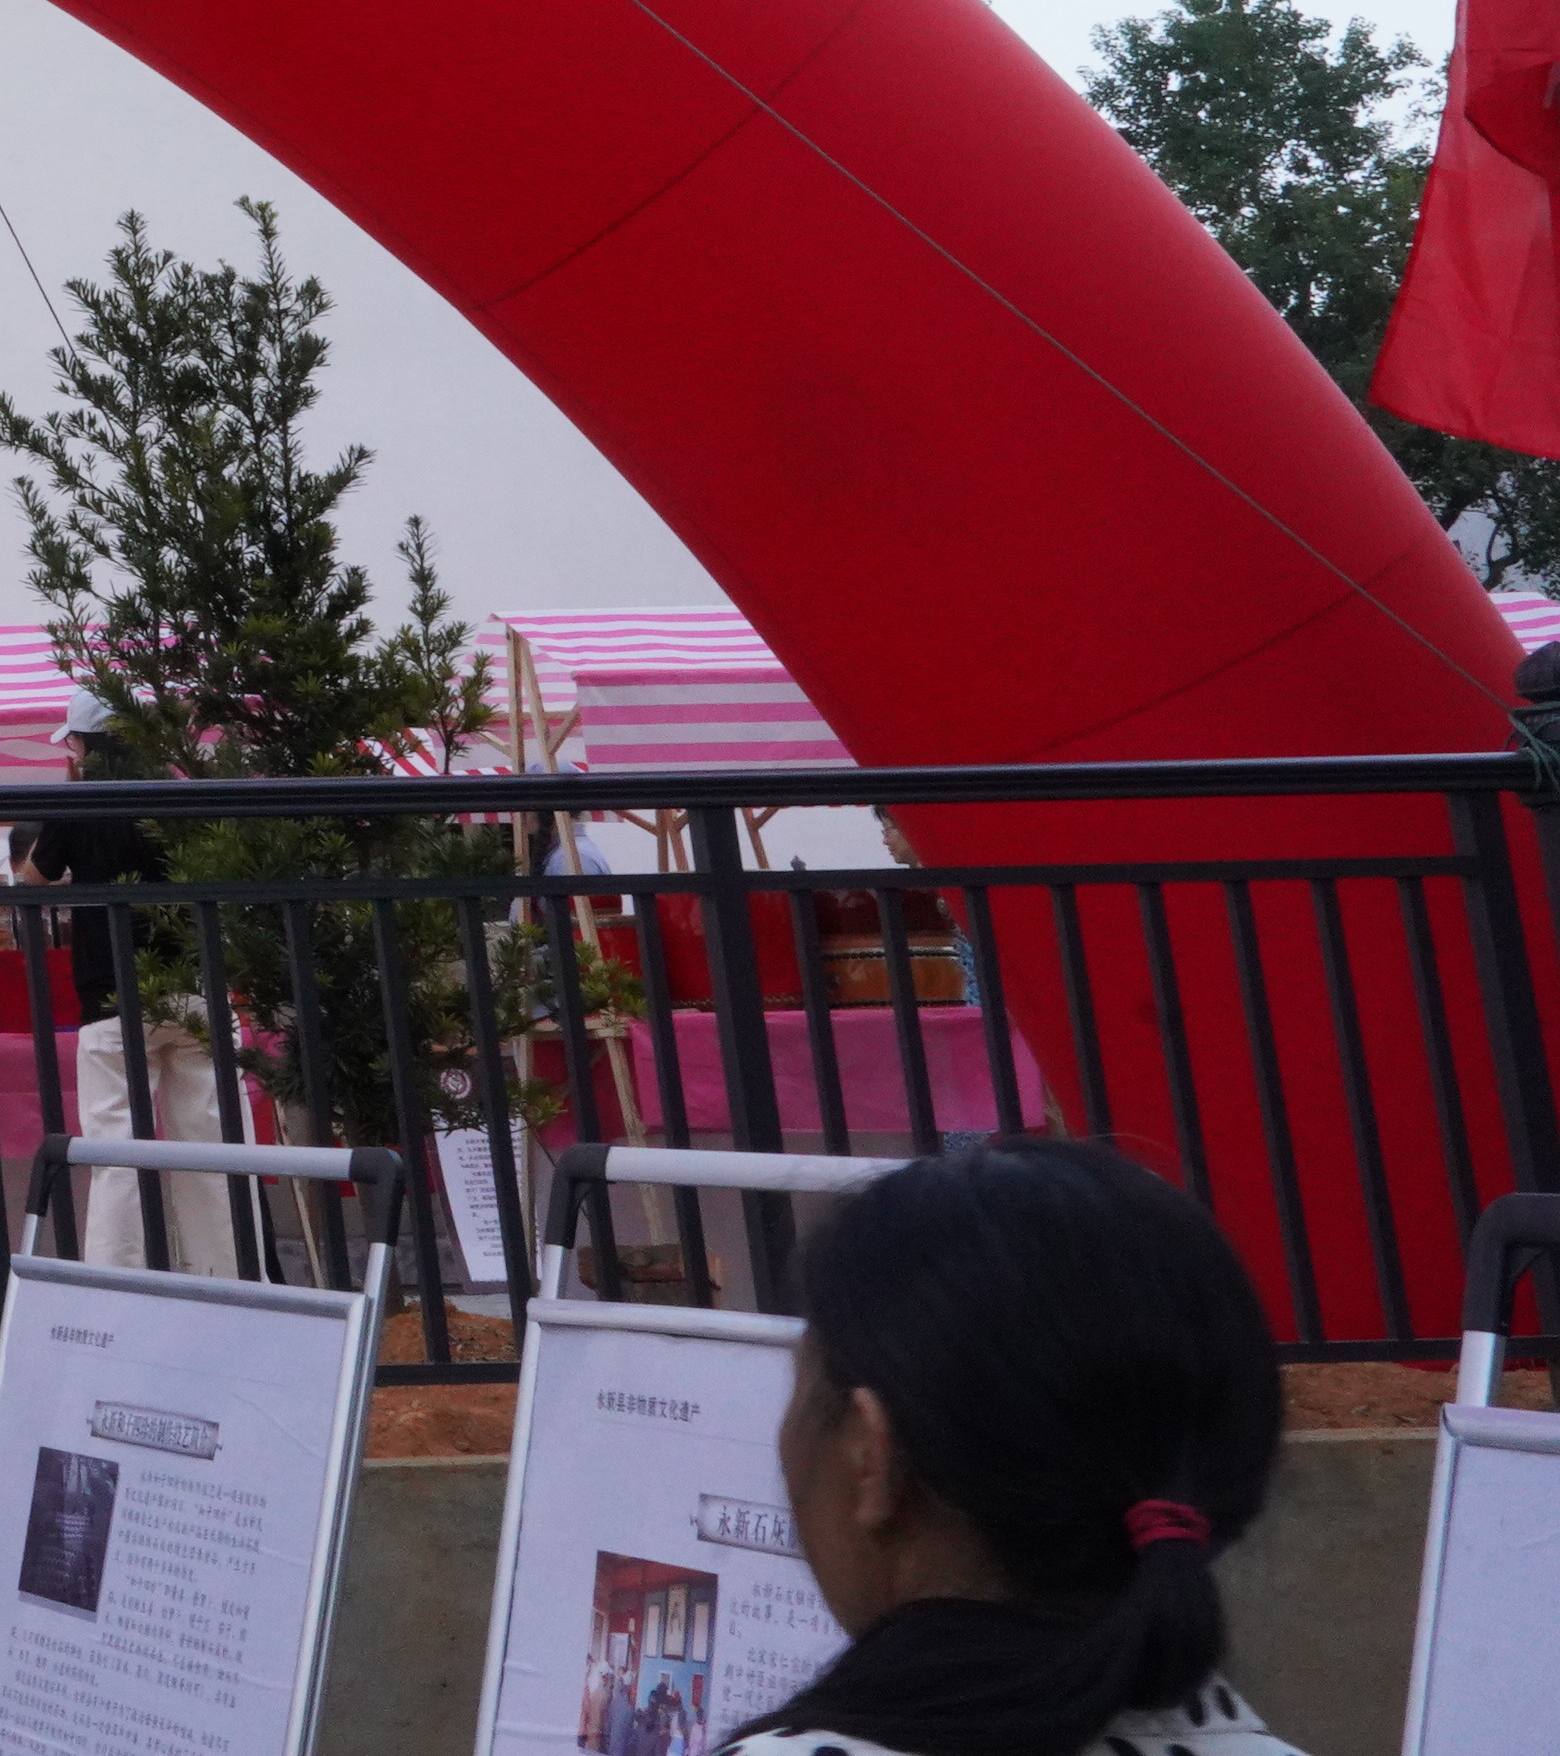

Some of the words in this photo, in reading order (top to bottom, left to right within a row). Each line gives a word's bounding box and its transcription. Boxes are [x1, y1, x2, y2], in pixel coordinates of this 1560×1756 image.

[596, 1388, 702, 1423] 永新县非物质文化遗产
